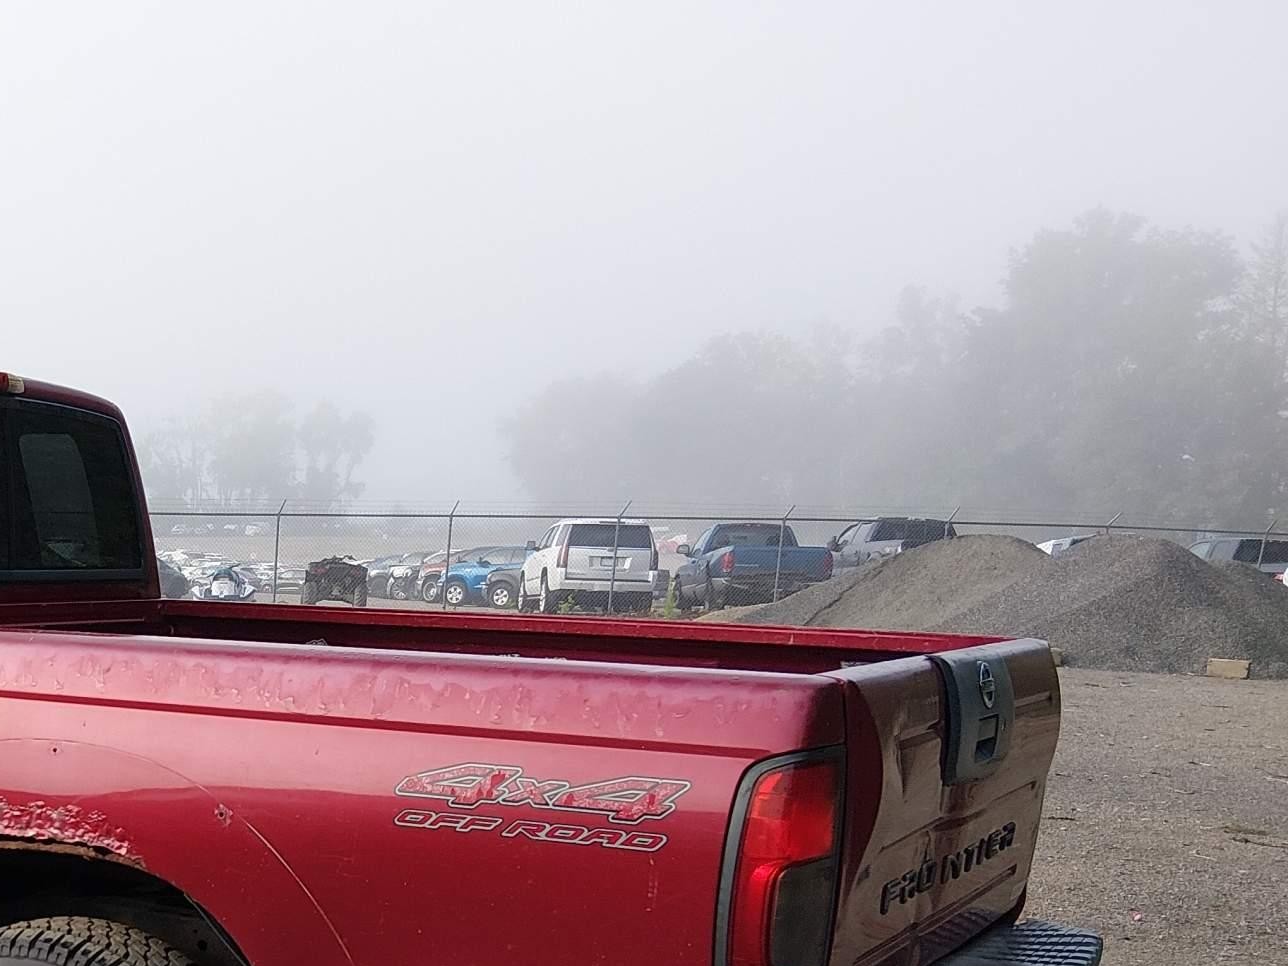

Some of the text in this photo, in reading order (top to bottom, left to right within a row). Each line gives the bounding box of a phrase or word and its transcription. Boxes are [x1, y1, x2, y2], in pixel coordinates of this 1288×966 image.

[394, 761, 692, 825] 4x4
[394, 809, 669, 853] OFF ROAD
[879, 821, 1016, 915] FRONTIER
